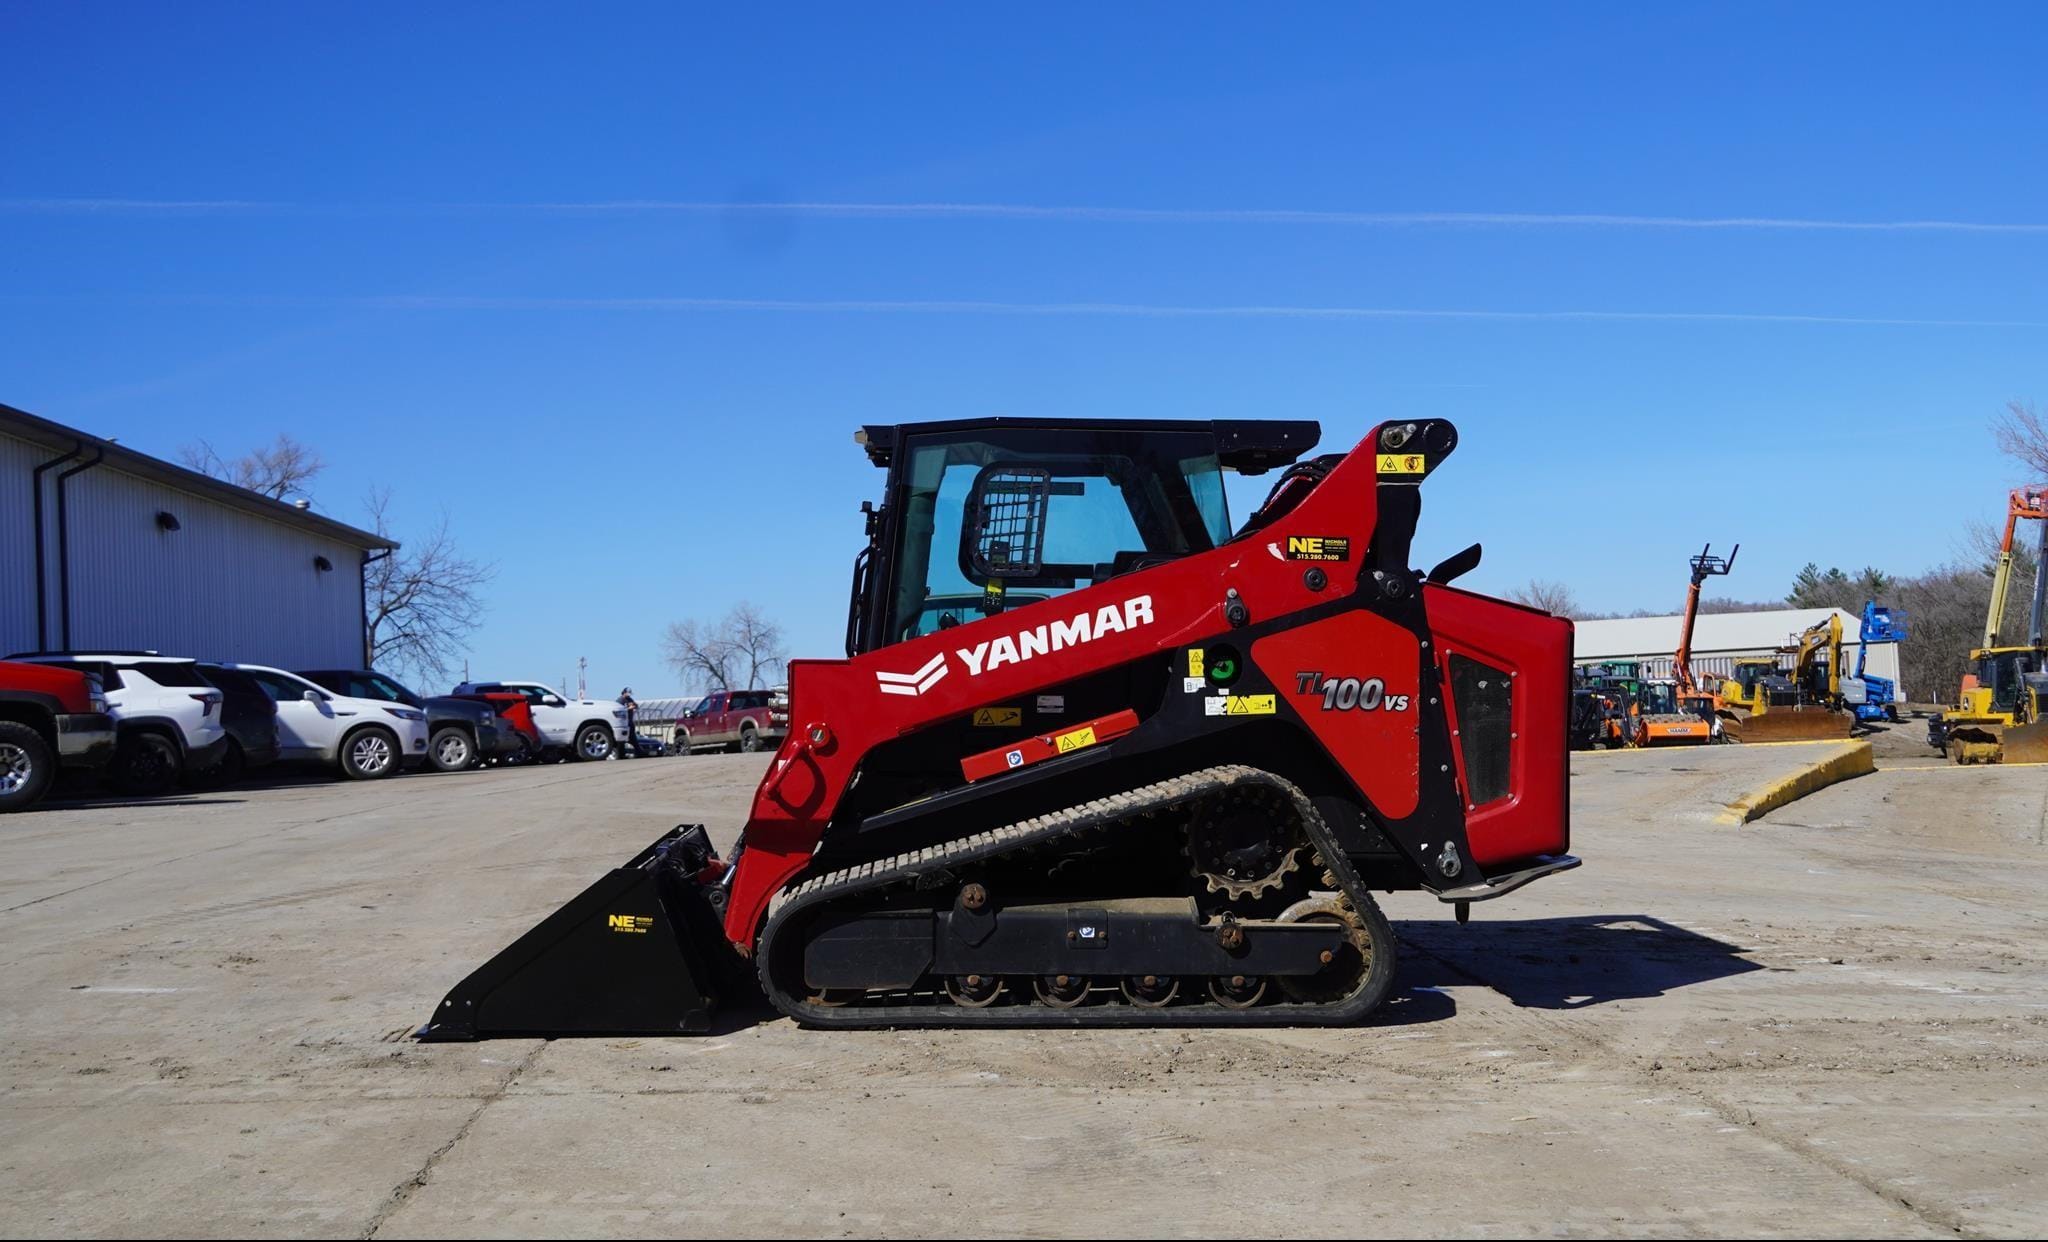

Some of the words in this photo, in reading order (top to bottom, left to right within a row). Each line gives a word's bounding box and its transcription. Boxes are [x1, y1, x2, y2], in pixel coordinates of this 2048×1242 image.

[1289, 537, 1323, 553] NE
[956, 594, 1154, 676] YANMAR
[609, 915, 635, 927] NE
